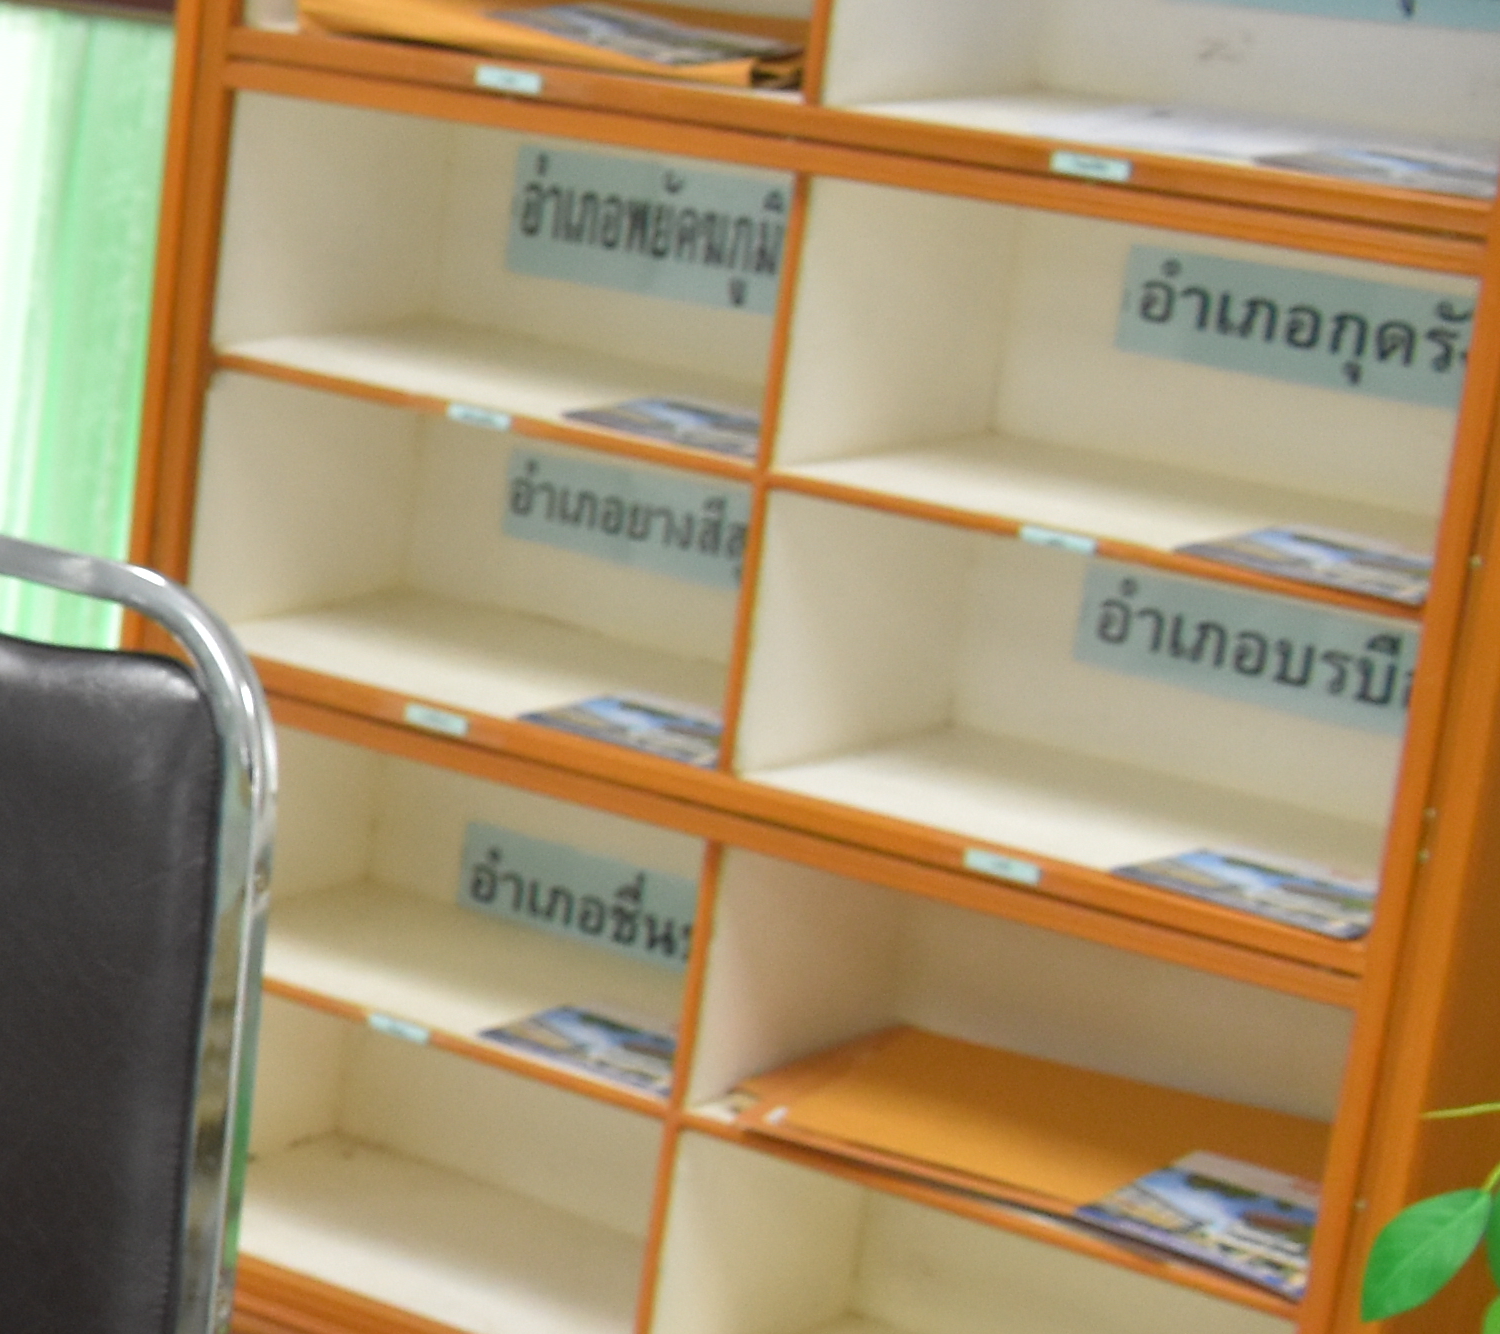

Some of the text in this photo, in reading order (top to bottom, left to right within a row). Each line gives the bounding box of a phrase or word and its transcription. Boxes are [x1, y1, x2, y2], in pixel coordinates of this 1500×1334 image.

[1140, 259, 1469, 386] อำเภอกุดรั
[1094, 578, 1415, 709] อำเภอบรบื
[469, 849, 691, 961] อำเภอชื่น
